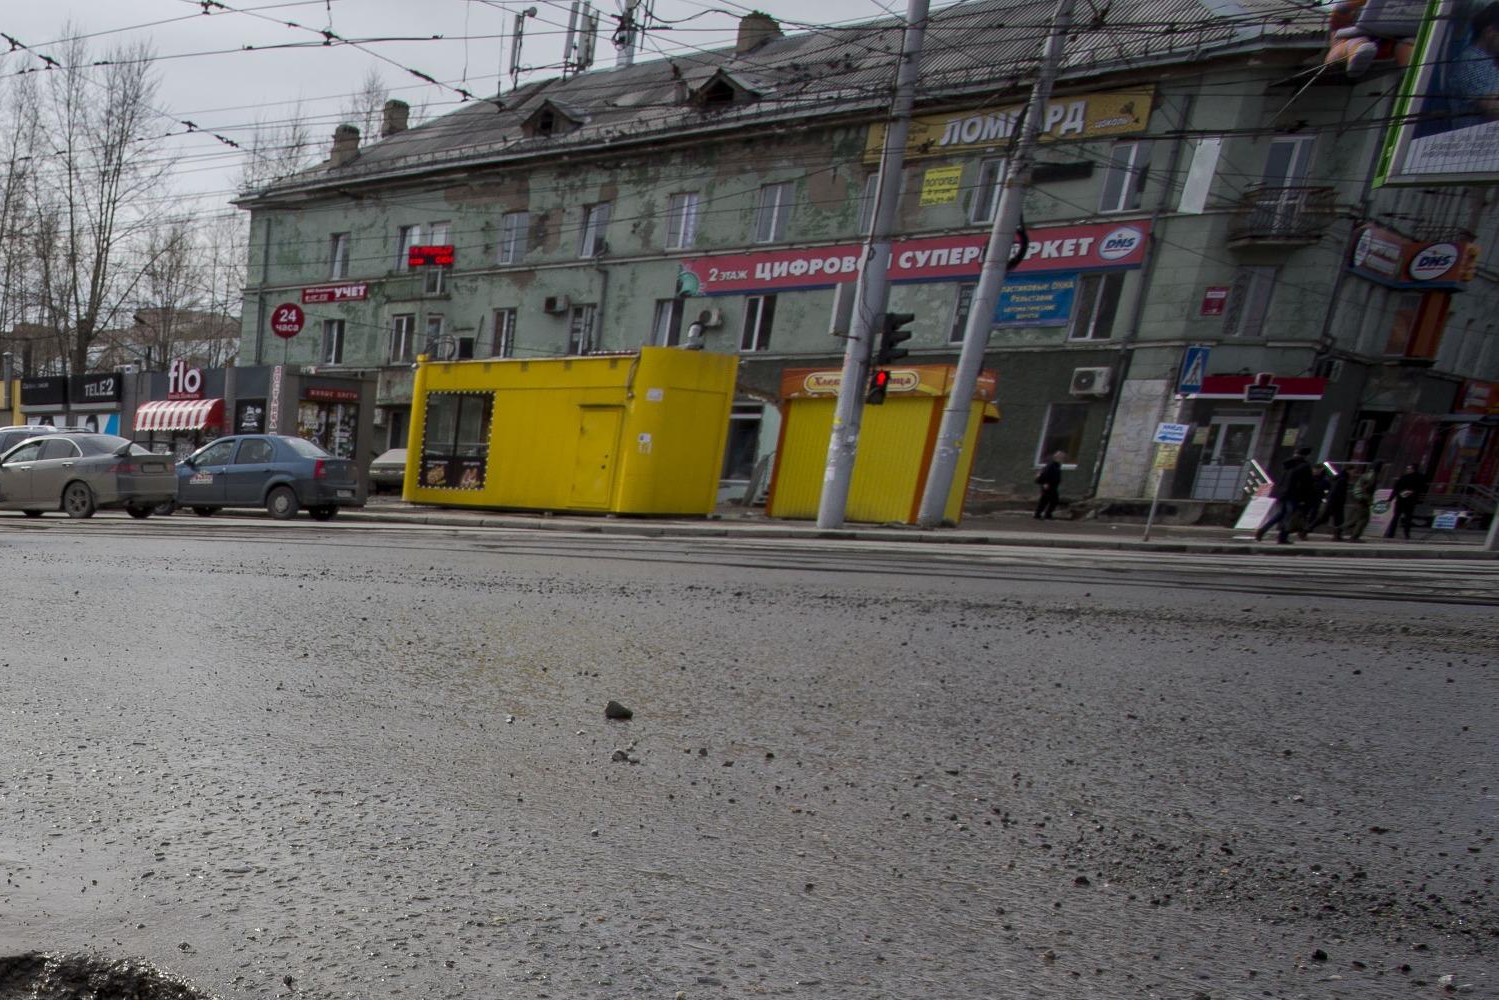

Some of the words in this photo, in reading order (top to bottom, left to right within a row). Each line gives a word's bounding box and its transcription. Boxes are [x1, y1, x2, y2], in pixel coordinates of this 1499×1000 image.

[939, 101, 1087, 146] ЛОМБРД
[709, 268, 718, 282] 2
[719, 269, 748, 281] ЭТАЖ
[754, 253, 893, 281] ЦИФРОВ
[898, 237, 1095, 270] СУПЕРАРКЕТ
[333, 285, 367, 298] УЧЕТ
[279, 309, 297, 323] 24
[85, 378, 115, 397] TELE2
[168, 359, 201, 393] flo
